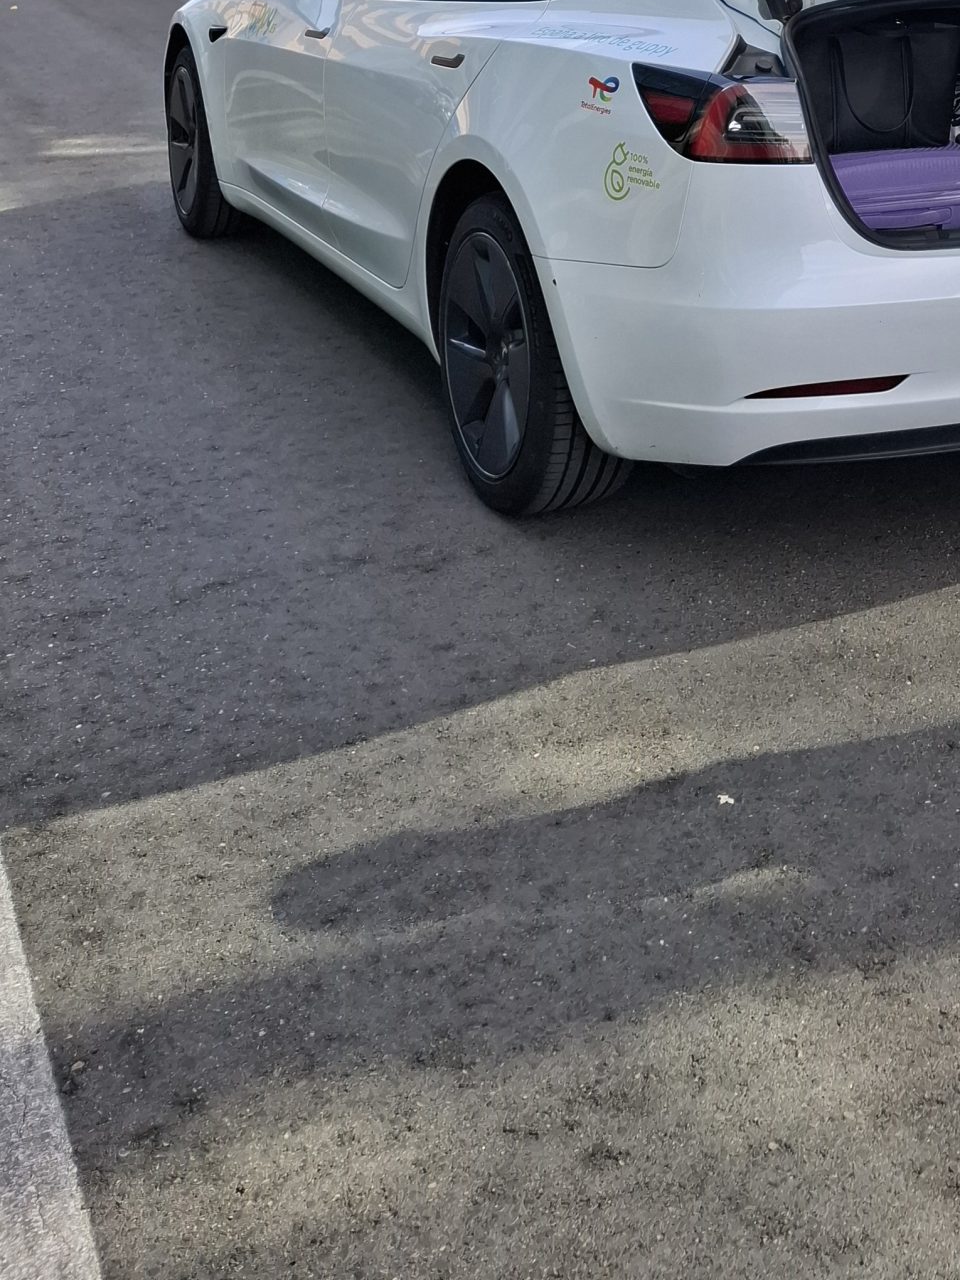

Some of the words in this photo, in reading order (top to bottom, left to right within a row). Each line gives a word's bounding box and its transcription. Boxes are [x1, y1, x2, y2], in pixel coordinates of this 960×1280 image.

[608, 35, 631, 47] de
[622, 41, 678, 57] guppy
[581, 100, 611, 114] TotalEnergies
[630, 152, 649, 165] 100%
[628, 165, 653, 177] energía
[626, 175, 661, 189] renovable
